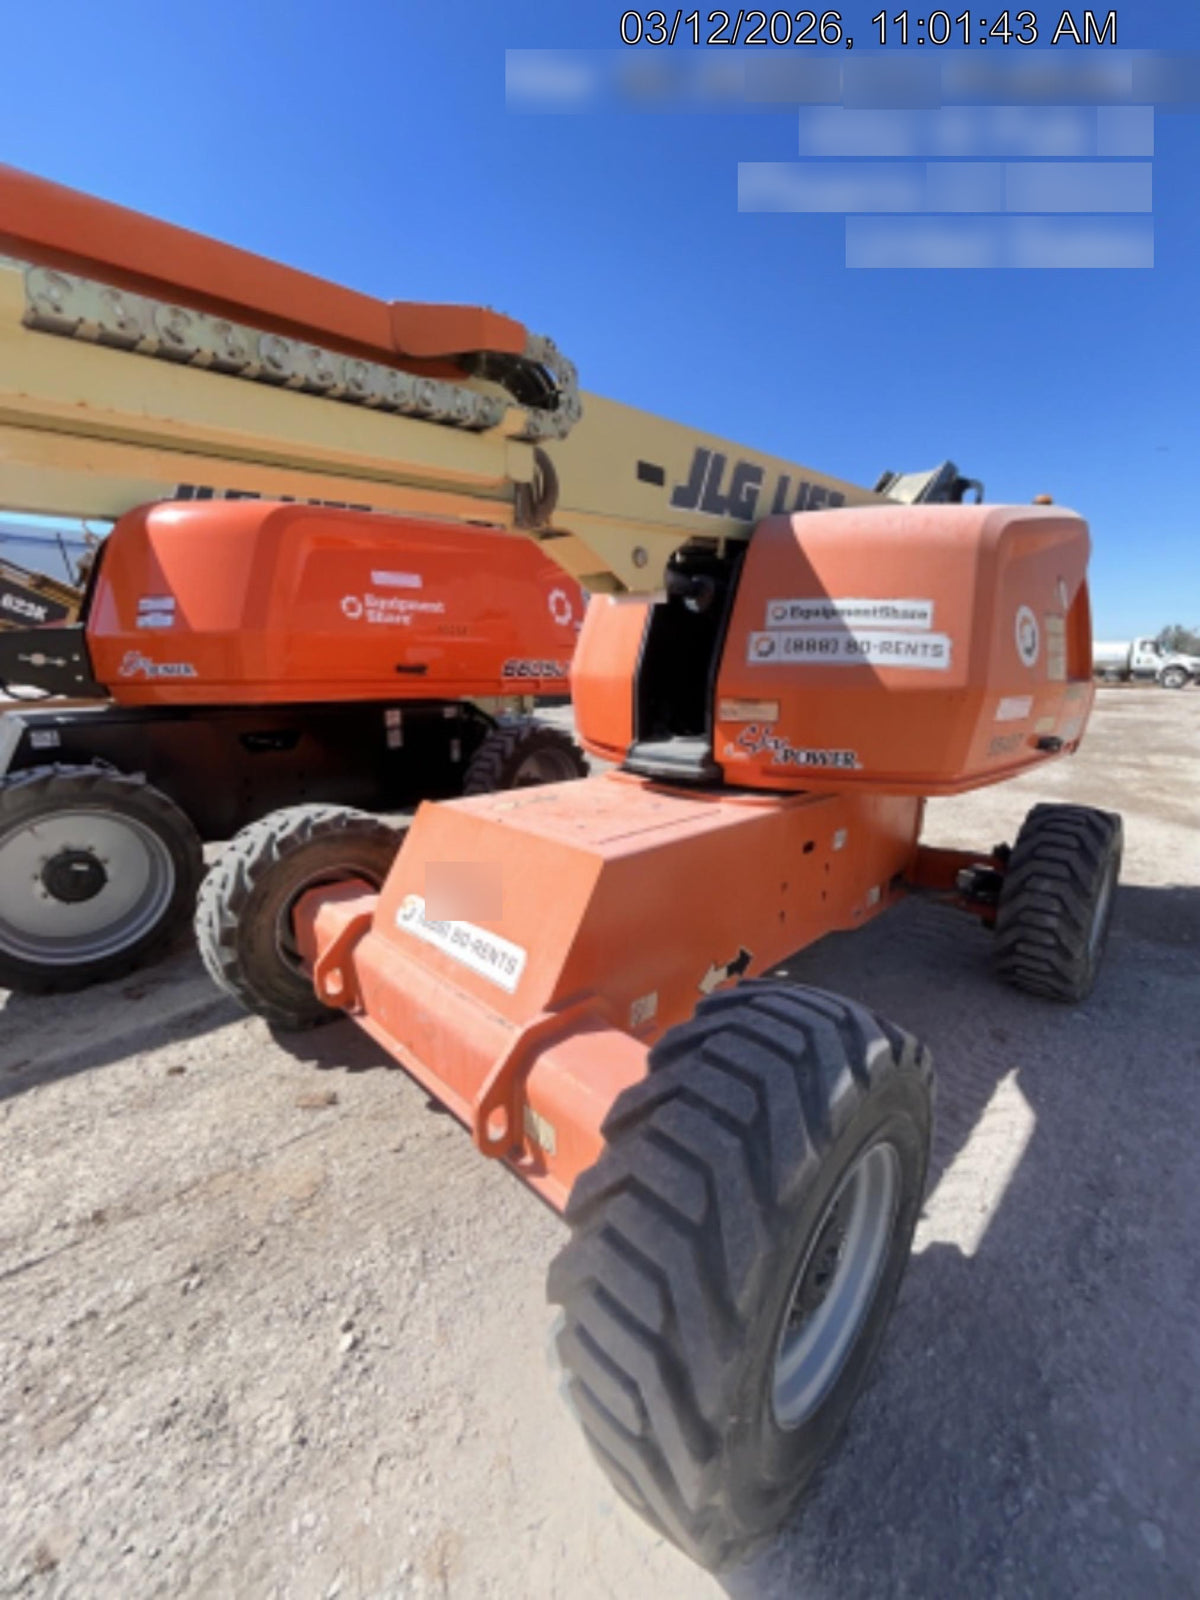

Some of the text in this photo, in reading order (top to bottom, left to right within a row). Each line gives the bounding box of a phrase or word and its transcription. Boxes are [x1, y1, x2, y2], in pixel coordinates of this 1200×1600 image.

[669, 446, 764, 521] JLG
[789, 605, 929, 620] EquipmentShare
[784, 636, 945, 658] (888) 80-RENTS
[774, 748, 858, 768] POWER
